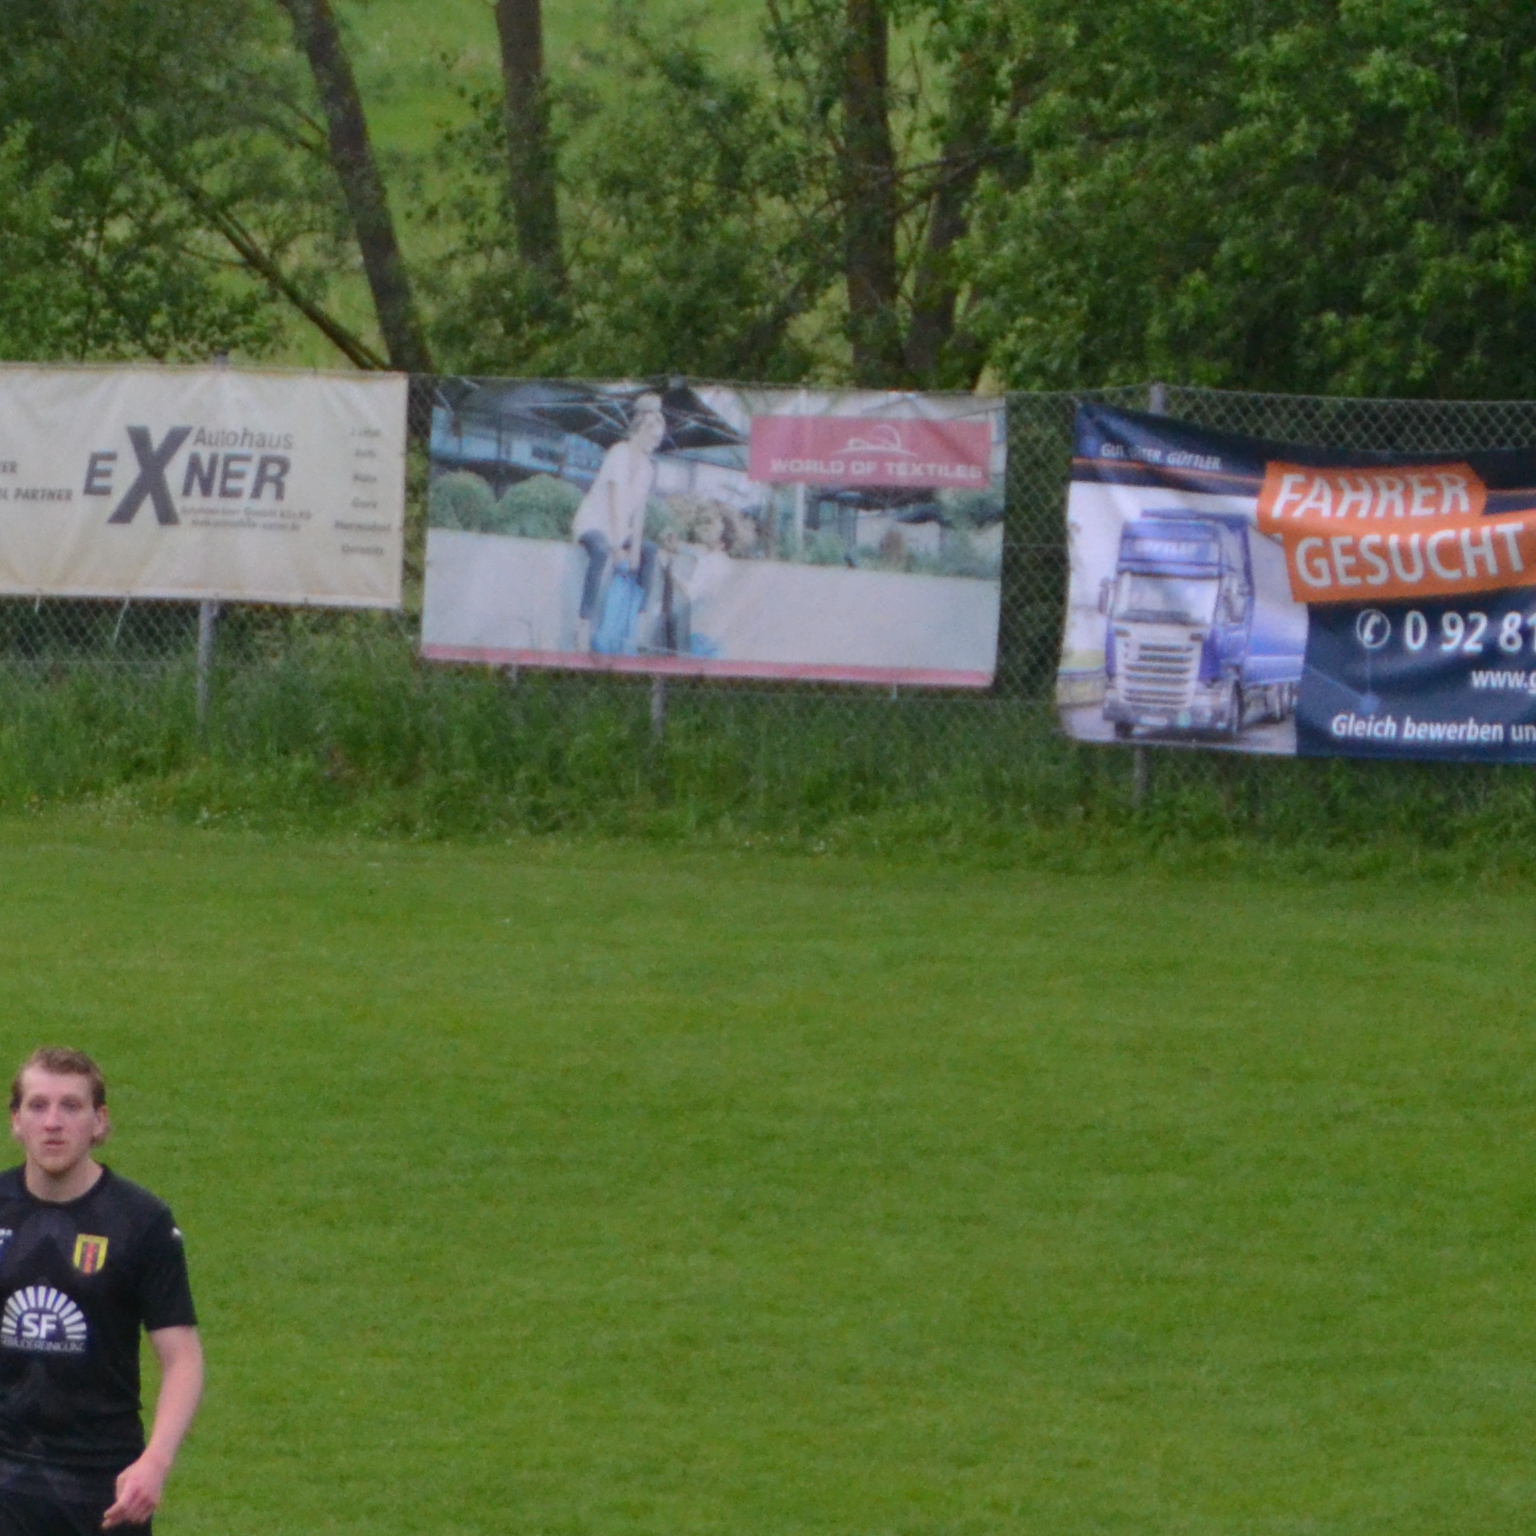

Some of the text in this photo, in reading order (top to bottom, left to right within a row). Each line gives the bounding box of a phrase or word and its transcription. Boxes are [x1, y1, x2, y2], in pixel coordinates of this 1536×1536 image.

[193, 427, 294, 449] Autohaus
[83, 425, 291, 526] EXNER
[771, 459, 982, 479] WORLD OF TEXTILES
[1271, 473, 1470, 518] FAHRER
[1295, 522, 1524, 588] GESUCHT
[1405, 610, 1428, 651] 0
[1441, 611, 1488, 653] 92
[1332, 714, 1397, 738] Gleich
[1403, 716, 1504, 742] bewerben
[21, 1312, 57, 1339] SF
